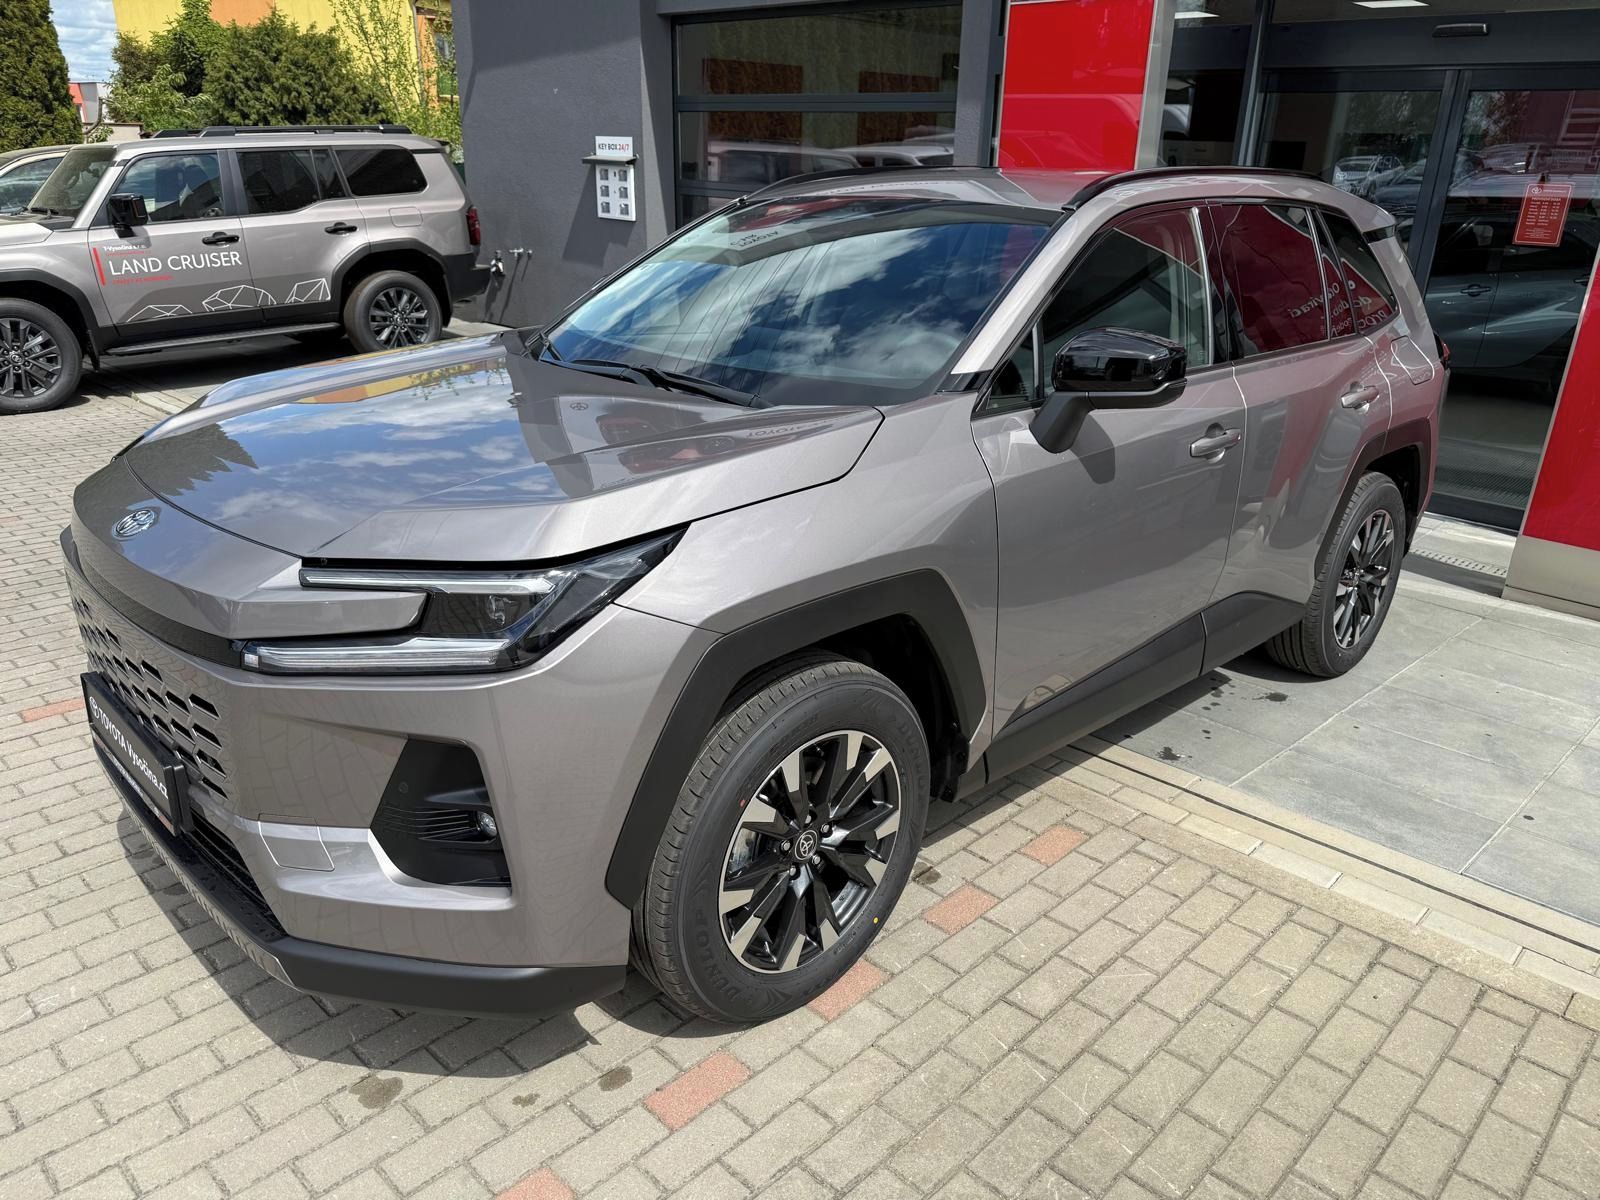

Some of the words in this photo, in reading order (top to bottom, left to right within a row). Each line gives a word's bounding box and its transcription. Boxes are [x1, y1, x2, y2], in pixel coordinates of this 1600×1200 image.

[608, 143, 618, 151] BOX
[109, 257, 162, 276] LAND
[167, 251, 242, 271] CRUISER
[99, 708, 127, 752] TOYOTA
